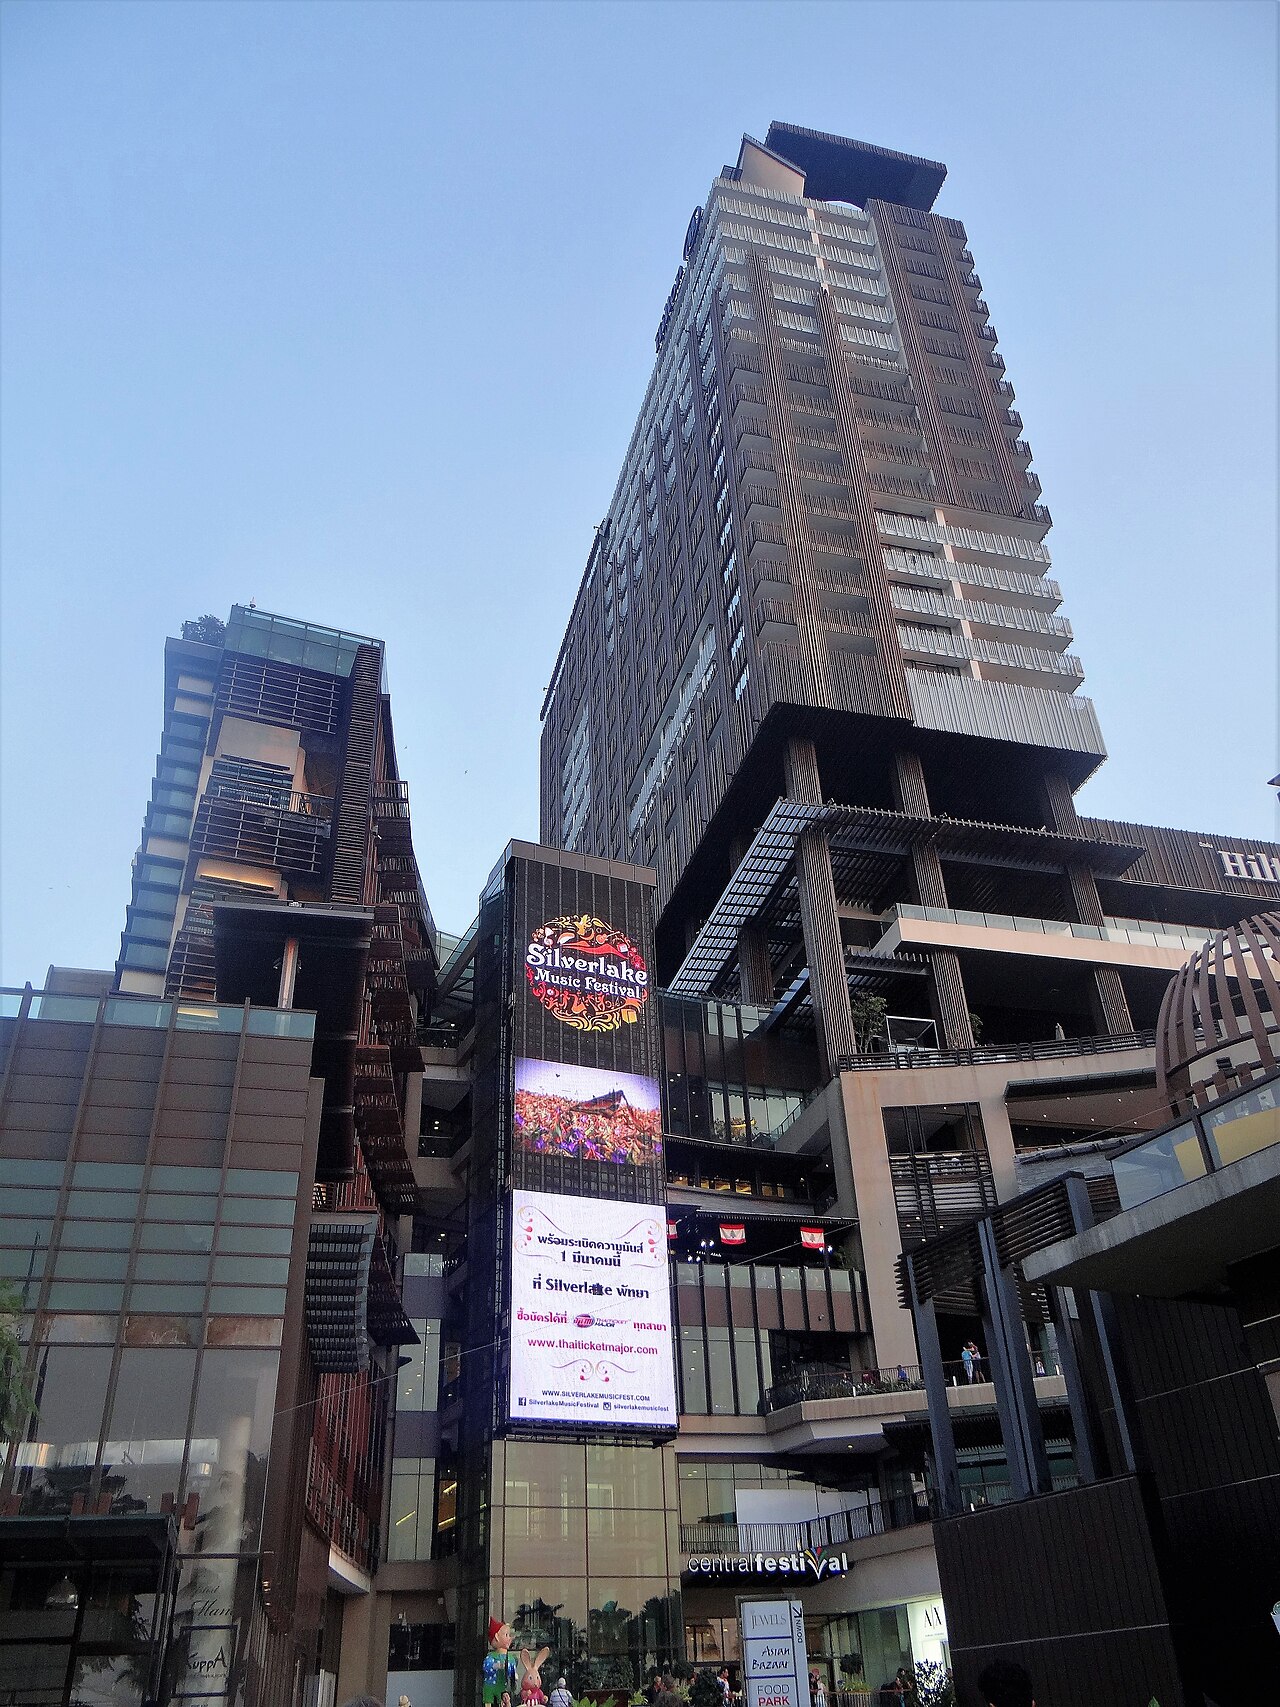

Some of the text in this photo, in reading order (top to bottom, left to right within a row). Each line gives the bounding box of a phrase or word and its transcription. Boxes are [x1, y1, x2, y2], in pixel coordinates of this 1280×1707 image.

[526, 943, 648, 986] Silverlake
[534, 967, 641, 999] Music Festival
[561, 1250, 566, 1262] 1
[616, 1284, 650, 1299] พัทยา
[527, 1338, 658, 1355] www.thaiticketmajor.com
[794, 1619, 803, 1643] DOWN
[761, 1645, 790, 1657] Asian
[752, 1659, 789, 1670] Bazaar
[757, 1684, 790, 1695] FOOD
[758, 1696, 790, 1707] PARK
